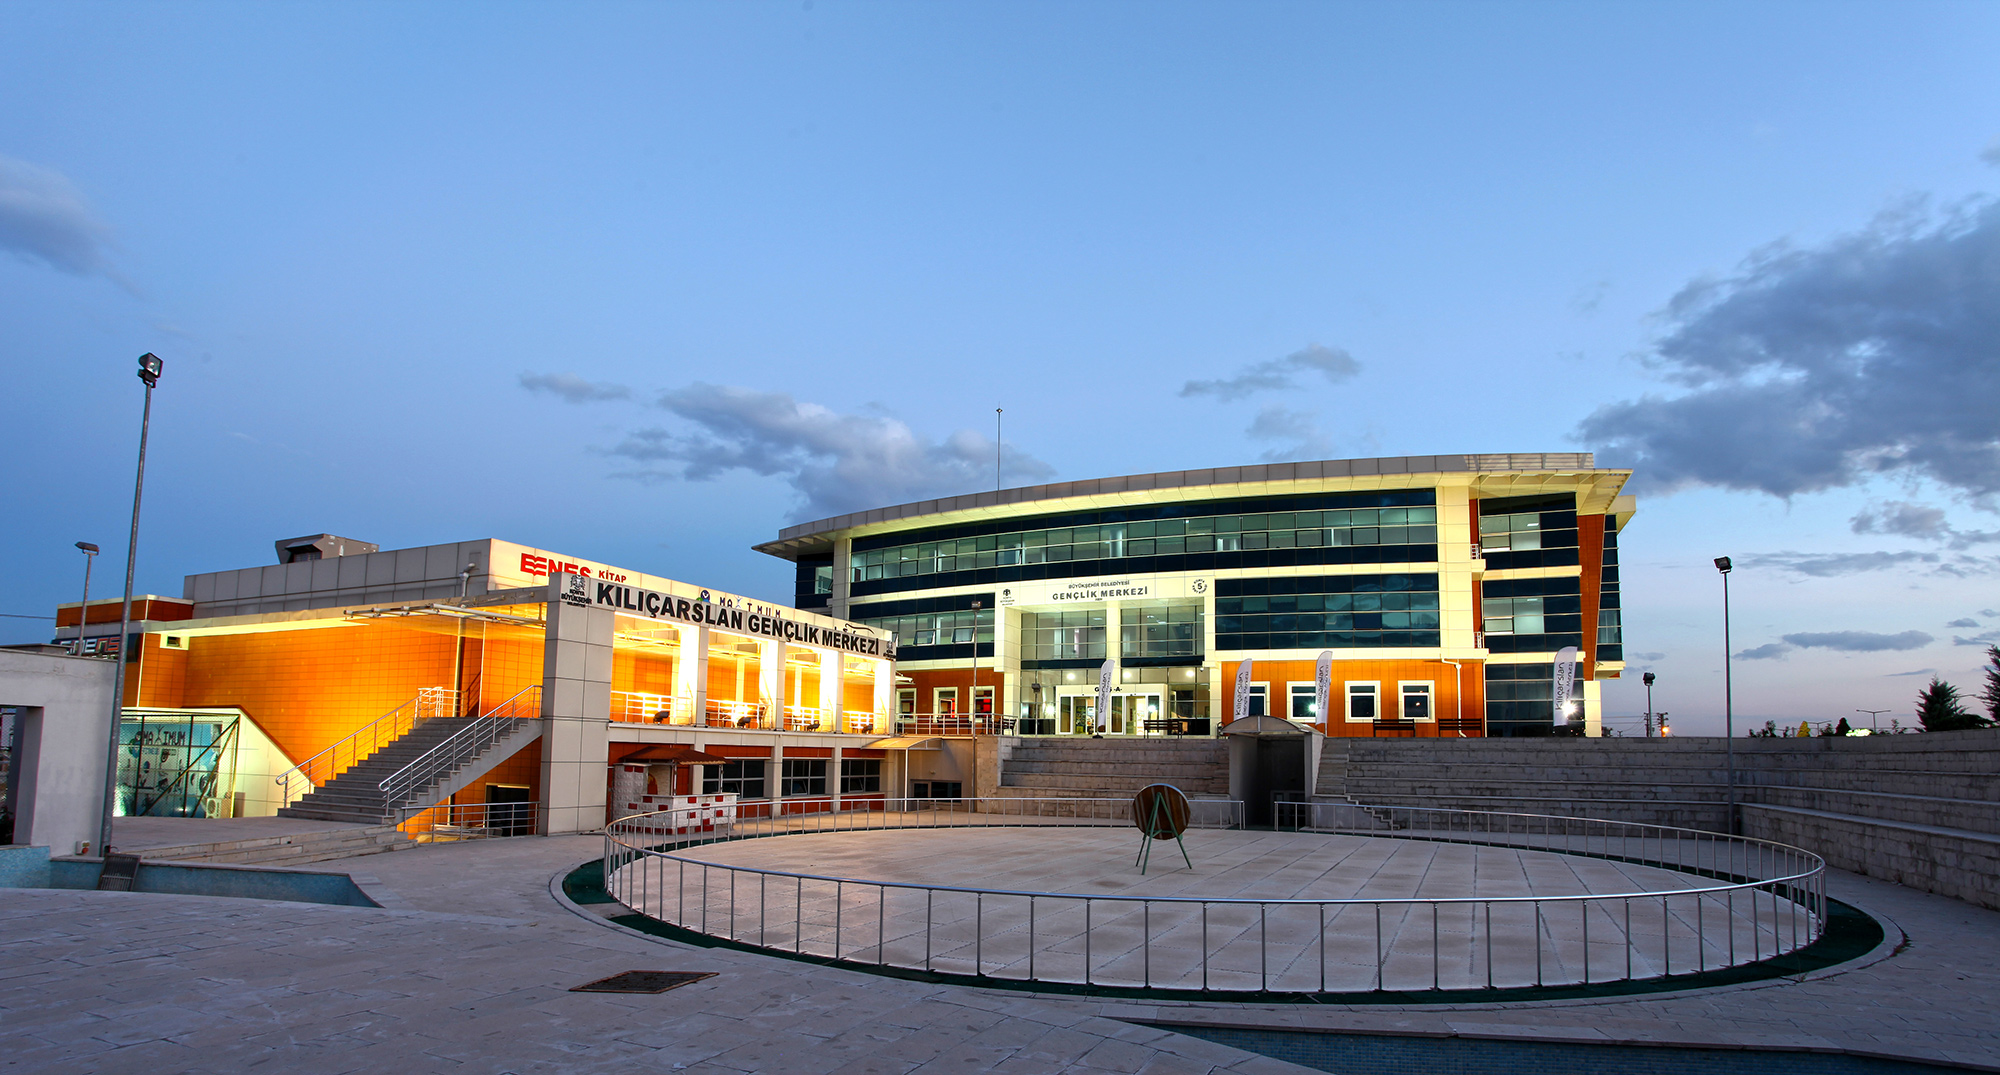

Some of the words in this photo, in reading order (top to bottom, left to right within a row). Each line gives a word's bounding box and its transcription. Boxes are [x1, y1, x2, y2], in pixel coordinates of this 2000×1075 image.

[599, 570, 626, 583] KİTAP
[1052, 590, 1097, 600] GENÇLİK
[1100, 586, 1148, 597] MERKEZİ
[597, 582, 743, 631] KILIÇARSLAN
[748, 614, 819, 645] GENÇLİK
[822, 629, 879, 656] MERKEZİ
